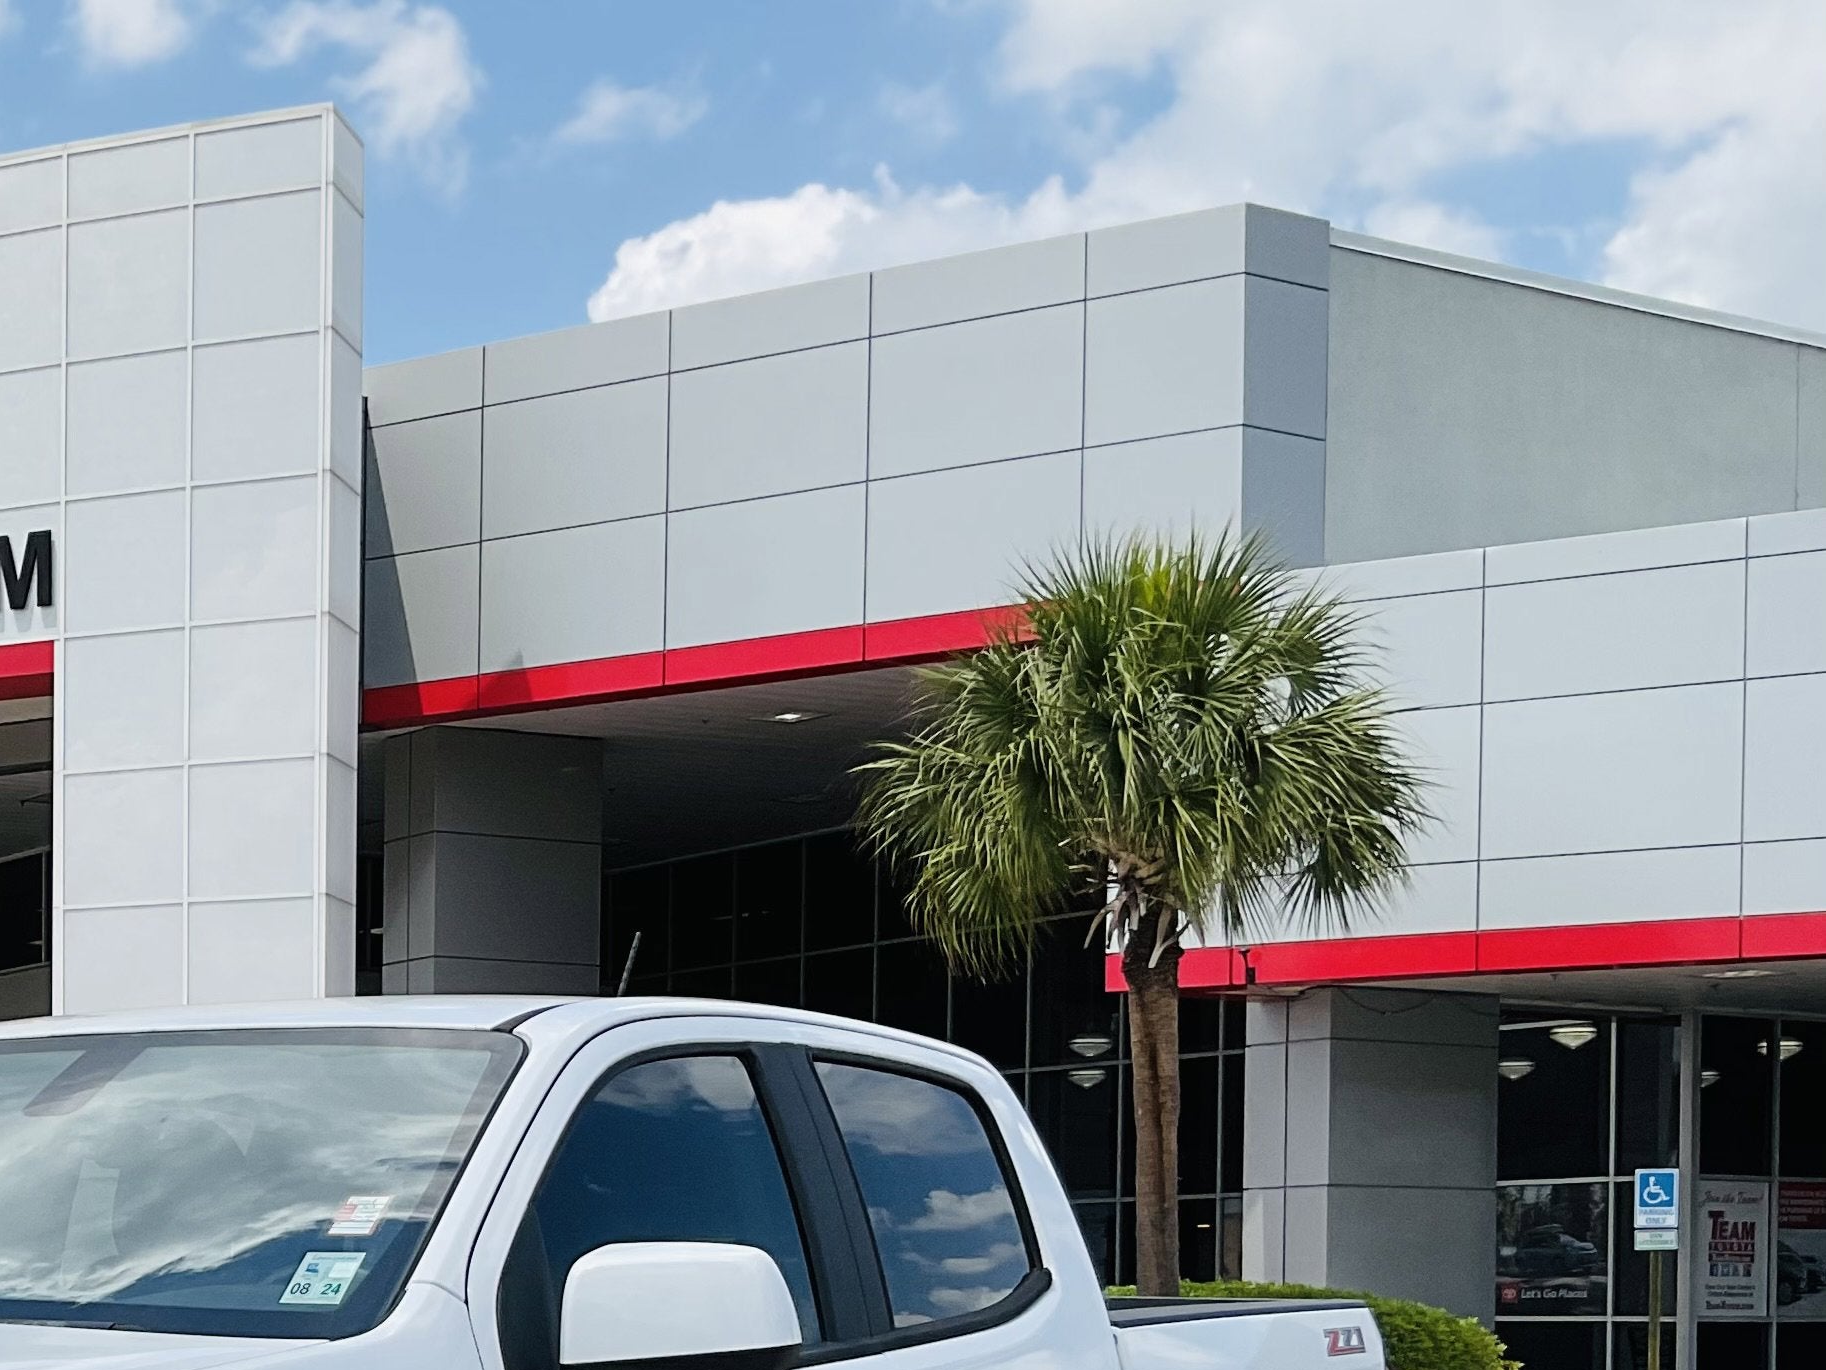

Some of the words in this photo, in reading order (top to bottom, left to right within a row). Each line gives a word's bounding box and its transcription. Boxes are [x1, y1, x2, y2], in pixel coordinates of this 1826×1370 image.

[290, 1283, 311, 1295] 08
[320, 1283, 342, 1295] 24
[1543, 1288, 1557, 1299] Go
[1323, 1326, 1366, 1357] Z71
